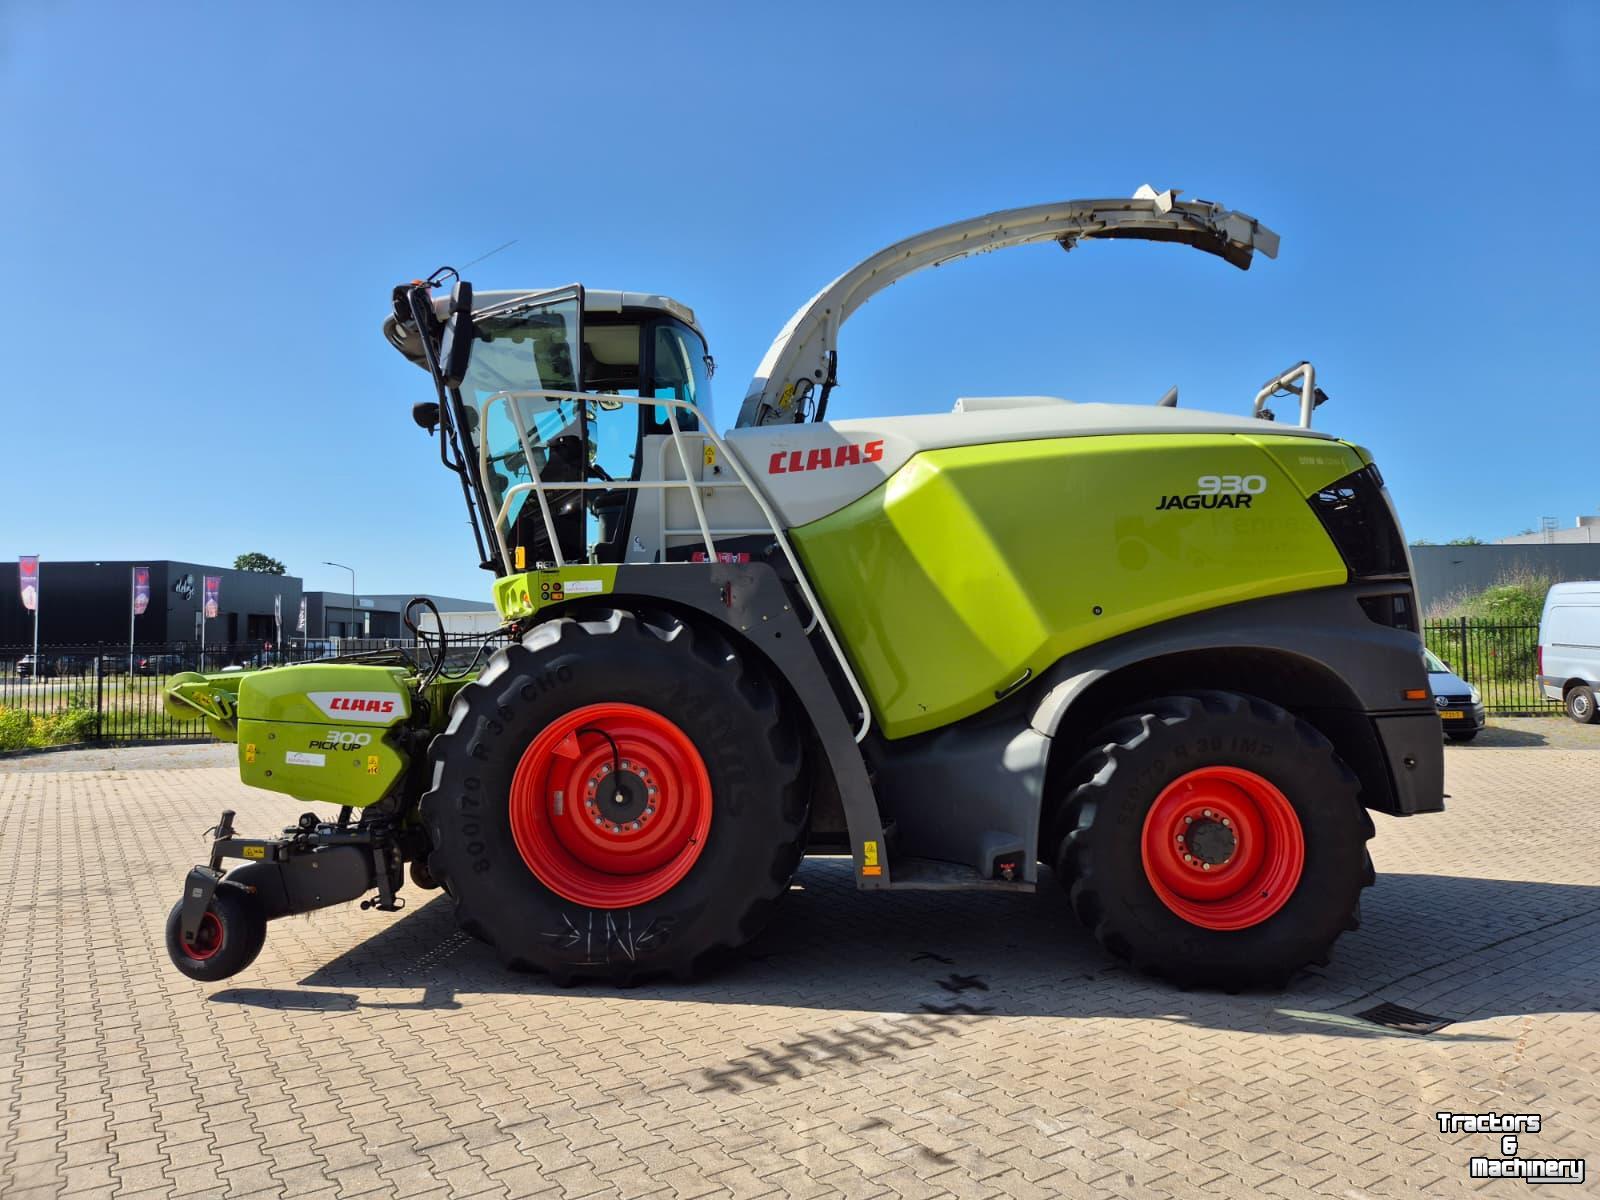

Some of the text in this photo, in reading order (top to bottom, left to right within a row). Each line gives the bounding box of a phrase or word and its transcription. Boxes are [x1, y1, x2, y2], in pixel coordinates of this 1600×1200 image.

[768, 440, 884, 475] CLAAS
[1197, 475, 1267, 495] 930
[1155, 494, 1253, 510] JAGUAR
[329, 697, 394, 713] CLAAS
[309, 740, 362, 751] PICK UP
[326, 730, 372, 746] 300
